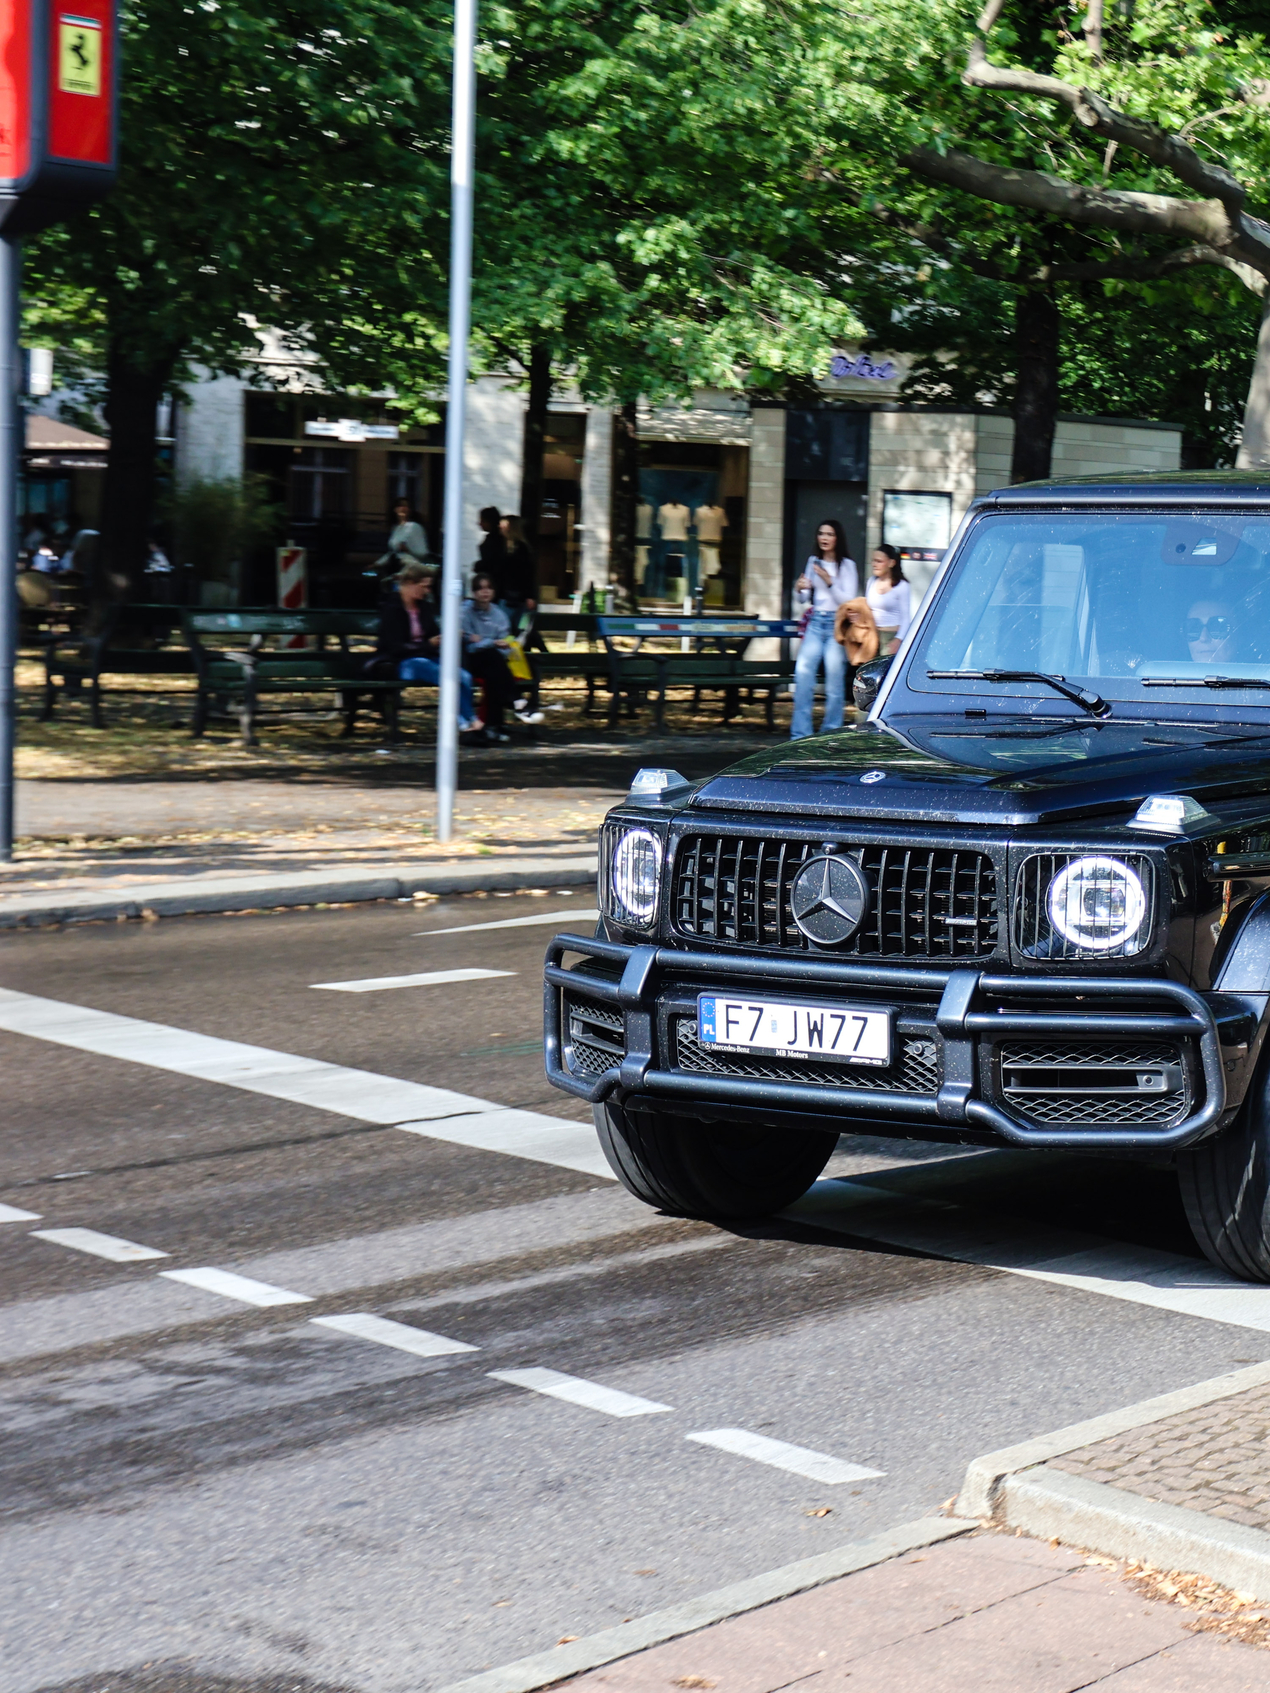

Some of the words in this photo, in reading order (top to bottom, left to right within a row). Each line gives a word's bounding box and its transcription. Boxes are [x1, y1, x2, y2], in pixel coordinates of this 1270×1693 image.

[703, 1023, 716, 1036] PL
[724, 1004, 764, 1042] F7
[787, 1010, 869, 1052] JW77
[710, 1042, 750, 1054] Mercedes-Benz
[775, 1048, 787, 1057] MB
[787, 1050, 809, 1059] Motors
